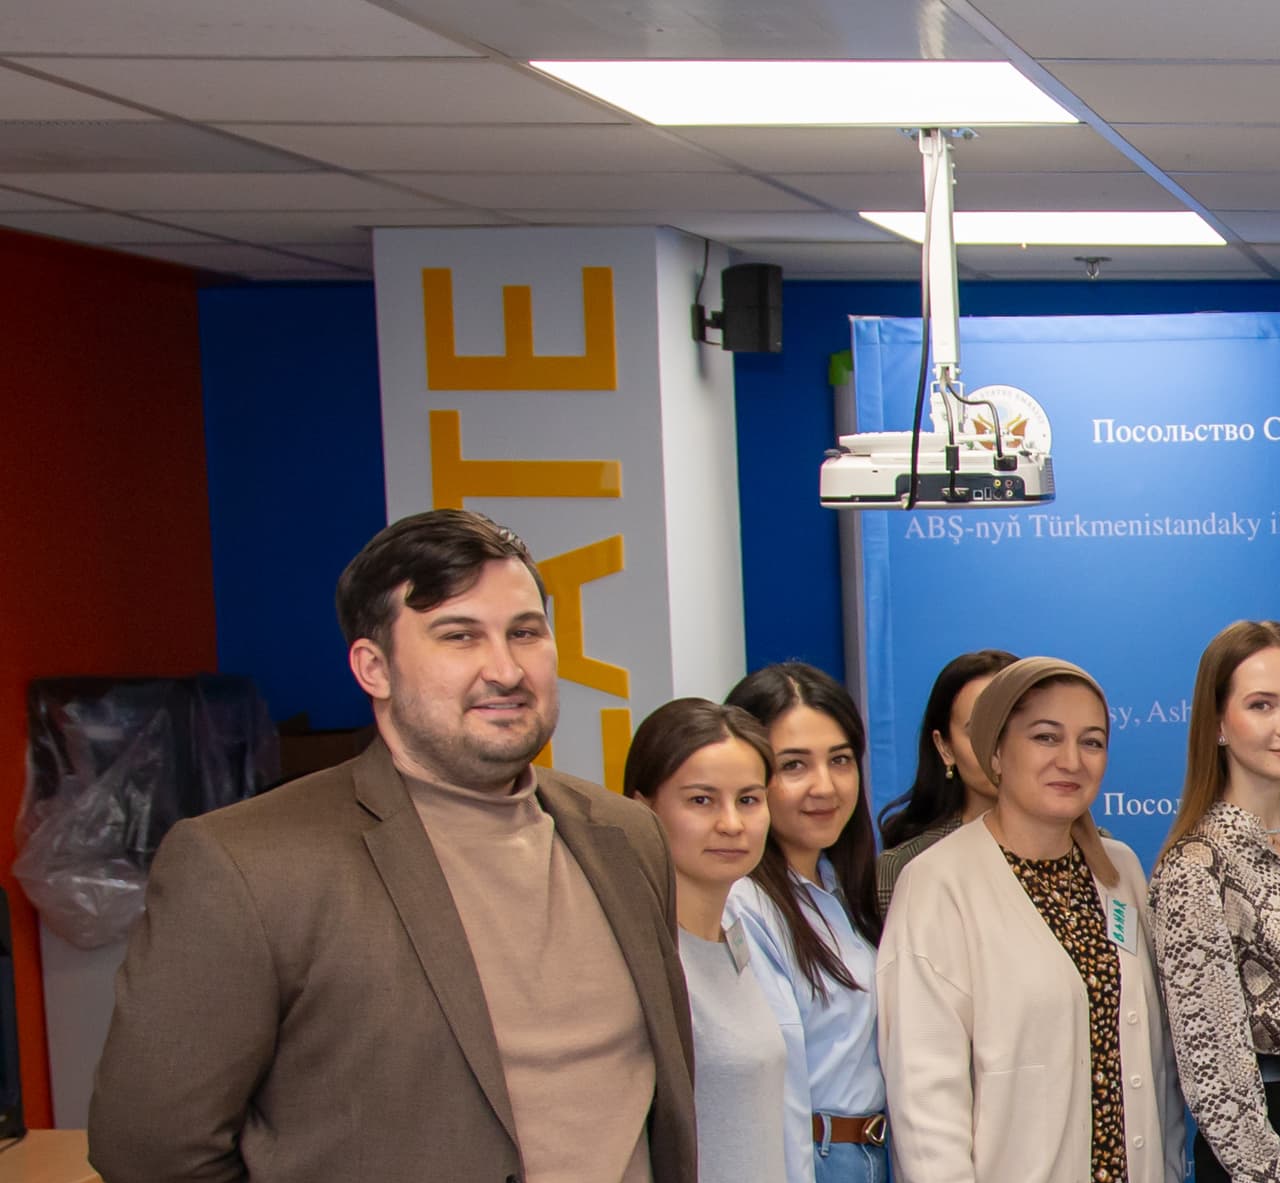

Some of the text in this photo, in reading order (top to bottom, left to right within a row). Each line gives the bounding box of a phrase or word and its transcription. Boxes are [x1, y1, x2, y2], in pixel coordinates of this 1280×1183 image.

[1092, 418, 1255, 443] Посольство
[422, 266, 631, 793] ATE
[905, 514, 1021, 544] ABŞ-nyň
[1029, 513, 1262, 541] Türkmenistandaky
